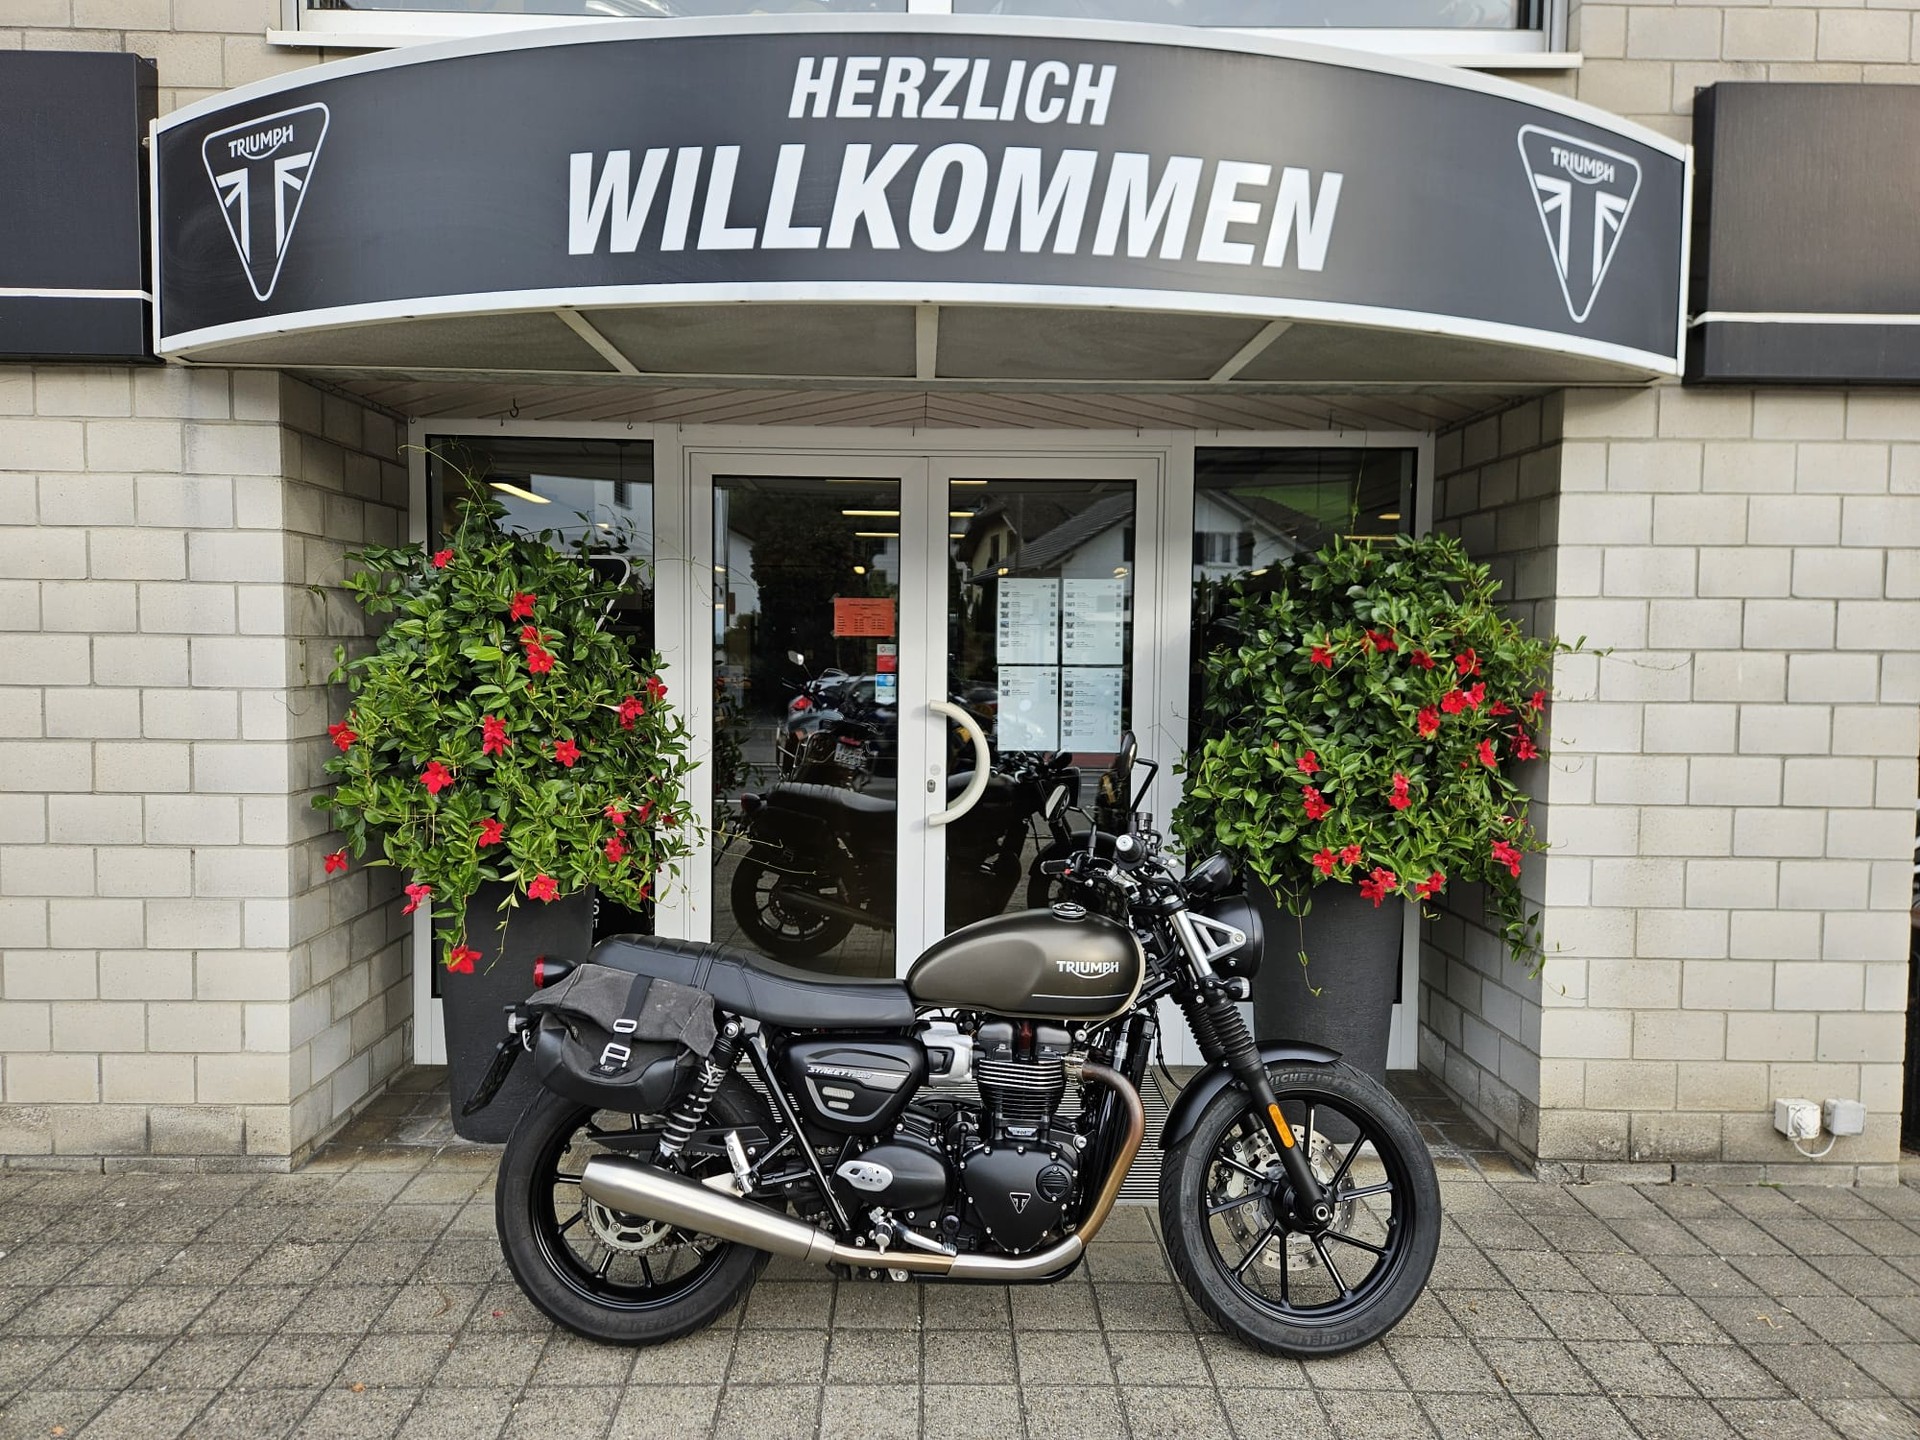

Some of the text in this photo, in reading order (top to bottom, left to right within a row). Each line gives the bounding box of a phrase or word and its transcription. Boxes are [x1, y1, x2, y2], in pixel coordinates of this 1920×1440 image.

[788, 56, 1117, 126] HERZLICH
[228, 124, 294, 160] TRIUMPH
[1551, 146, 1615, 184] TRIUMPH
[568, 143, 1344, 272] WILLKOMMEN
[1056, 960, 1119, 979] TRIUMPH
